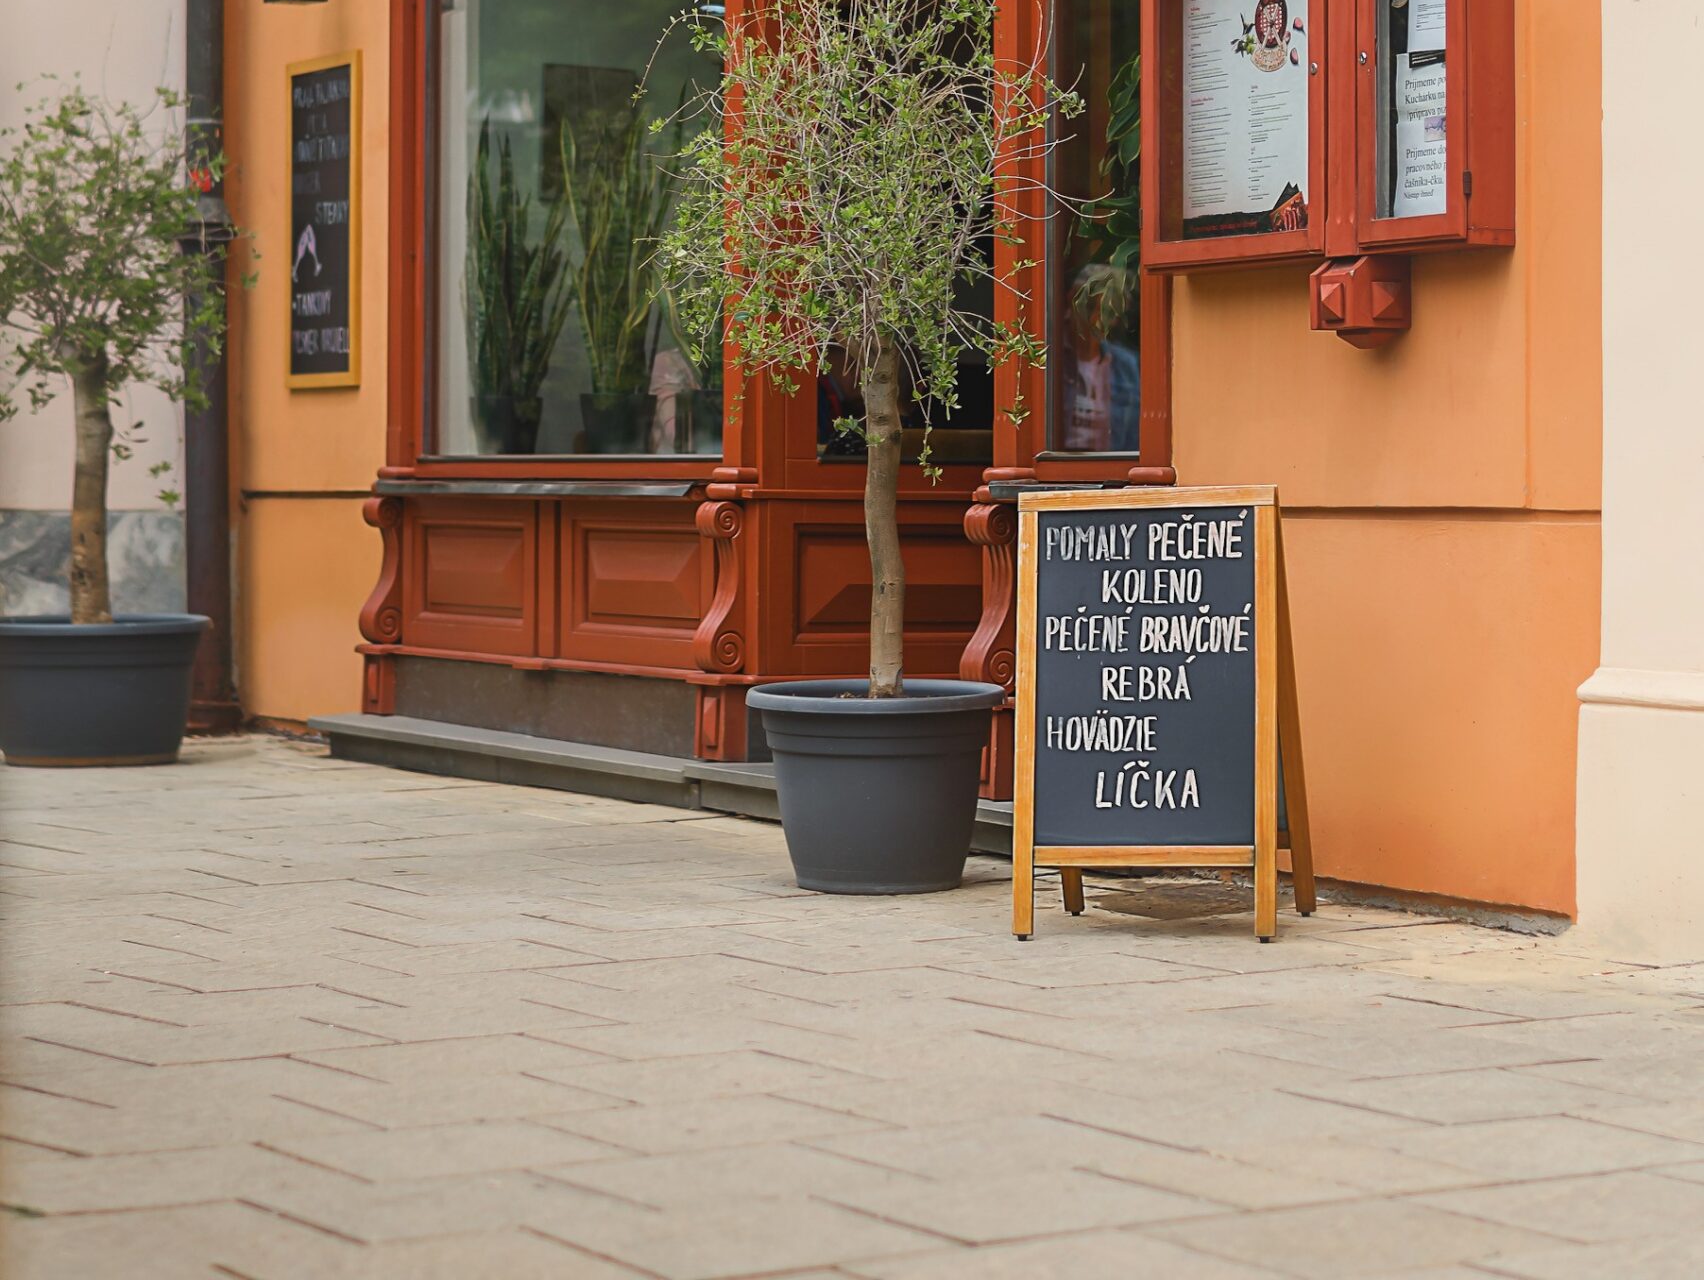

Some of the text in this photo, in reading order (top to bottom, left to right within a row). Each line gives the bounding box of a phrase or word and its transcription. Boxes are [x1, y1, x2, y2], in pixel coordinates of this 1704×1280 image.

[1046, 508, 1249, 562] POMALY PEČENÉ
[1101, 568, 1202, 605] KOLENO
[1045, 603, 1252, 653] PEČENÉ BRAVČOVÉ
[1101, 655, 1197, 701] REBRÁ
[1046, 710, 1158, 752] HOVÄDZIE
[1095, 760, 1201, 809] LÍČKA
